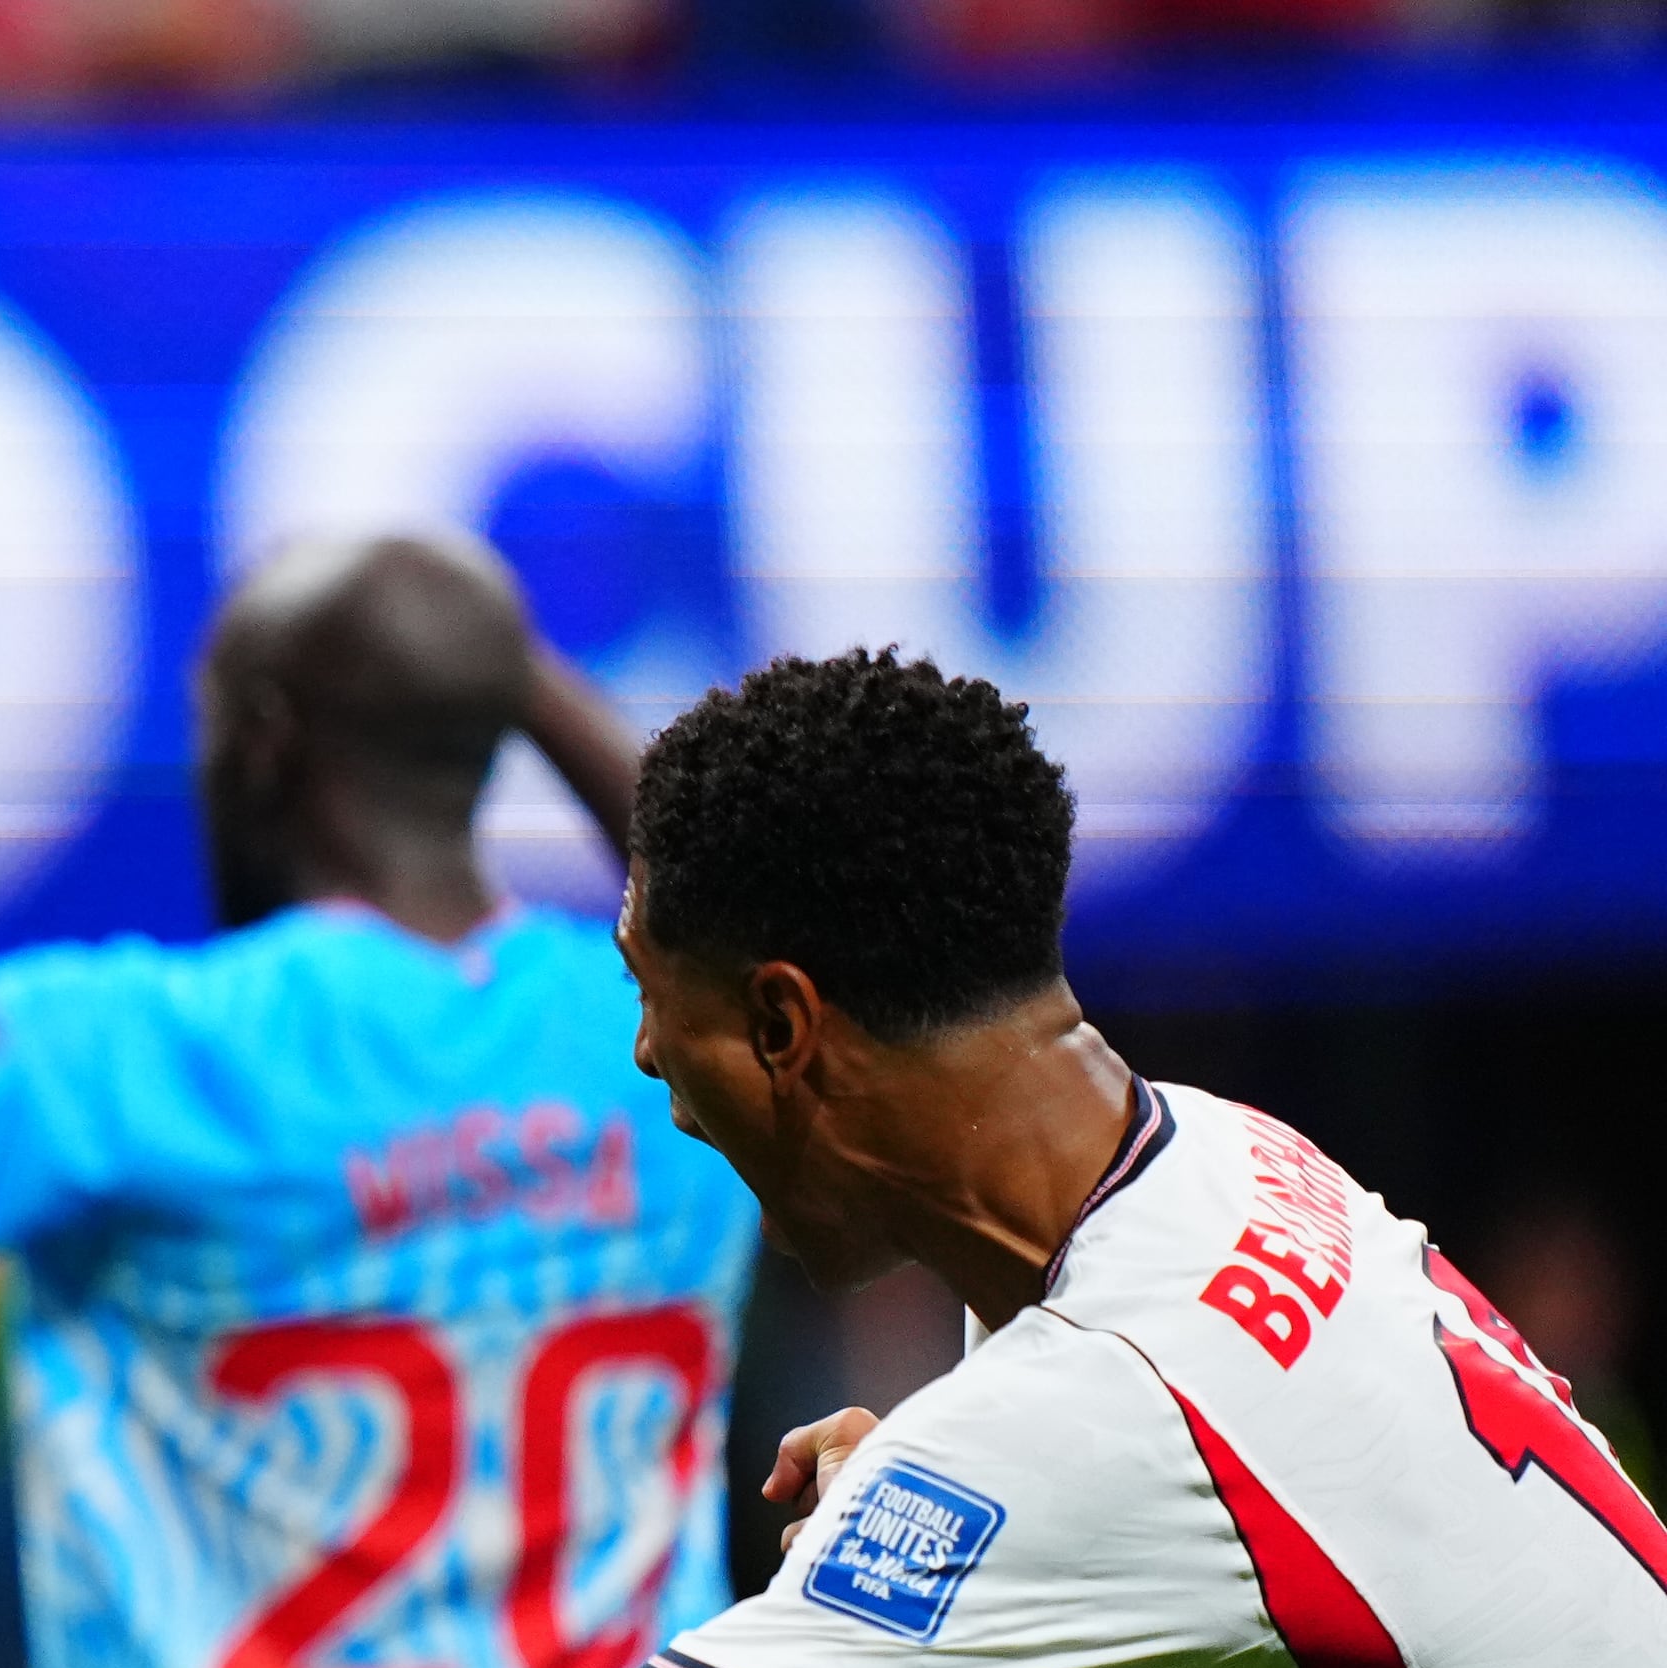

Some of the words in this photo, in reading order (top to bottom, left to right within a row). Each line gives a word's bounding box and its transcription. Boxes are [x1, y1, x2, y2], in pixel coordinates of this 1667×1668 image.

[217, 155, 1667, 880] CUP
[344, 1098, 637, 1240] WISSA
[855, 1503, 955, 1571] UNITES
[871, 1481, 965, 1543] FOOTBALL
[838, 1536, 873, 1569] the
[869, 1550, 941, 1598] World
[851, 1572, 892, 1601] FIFA
